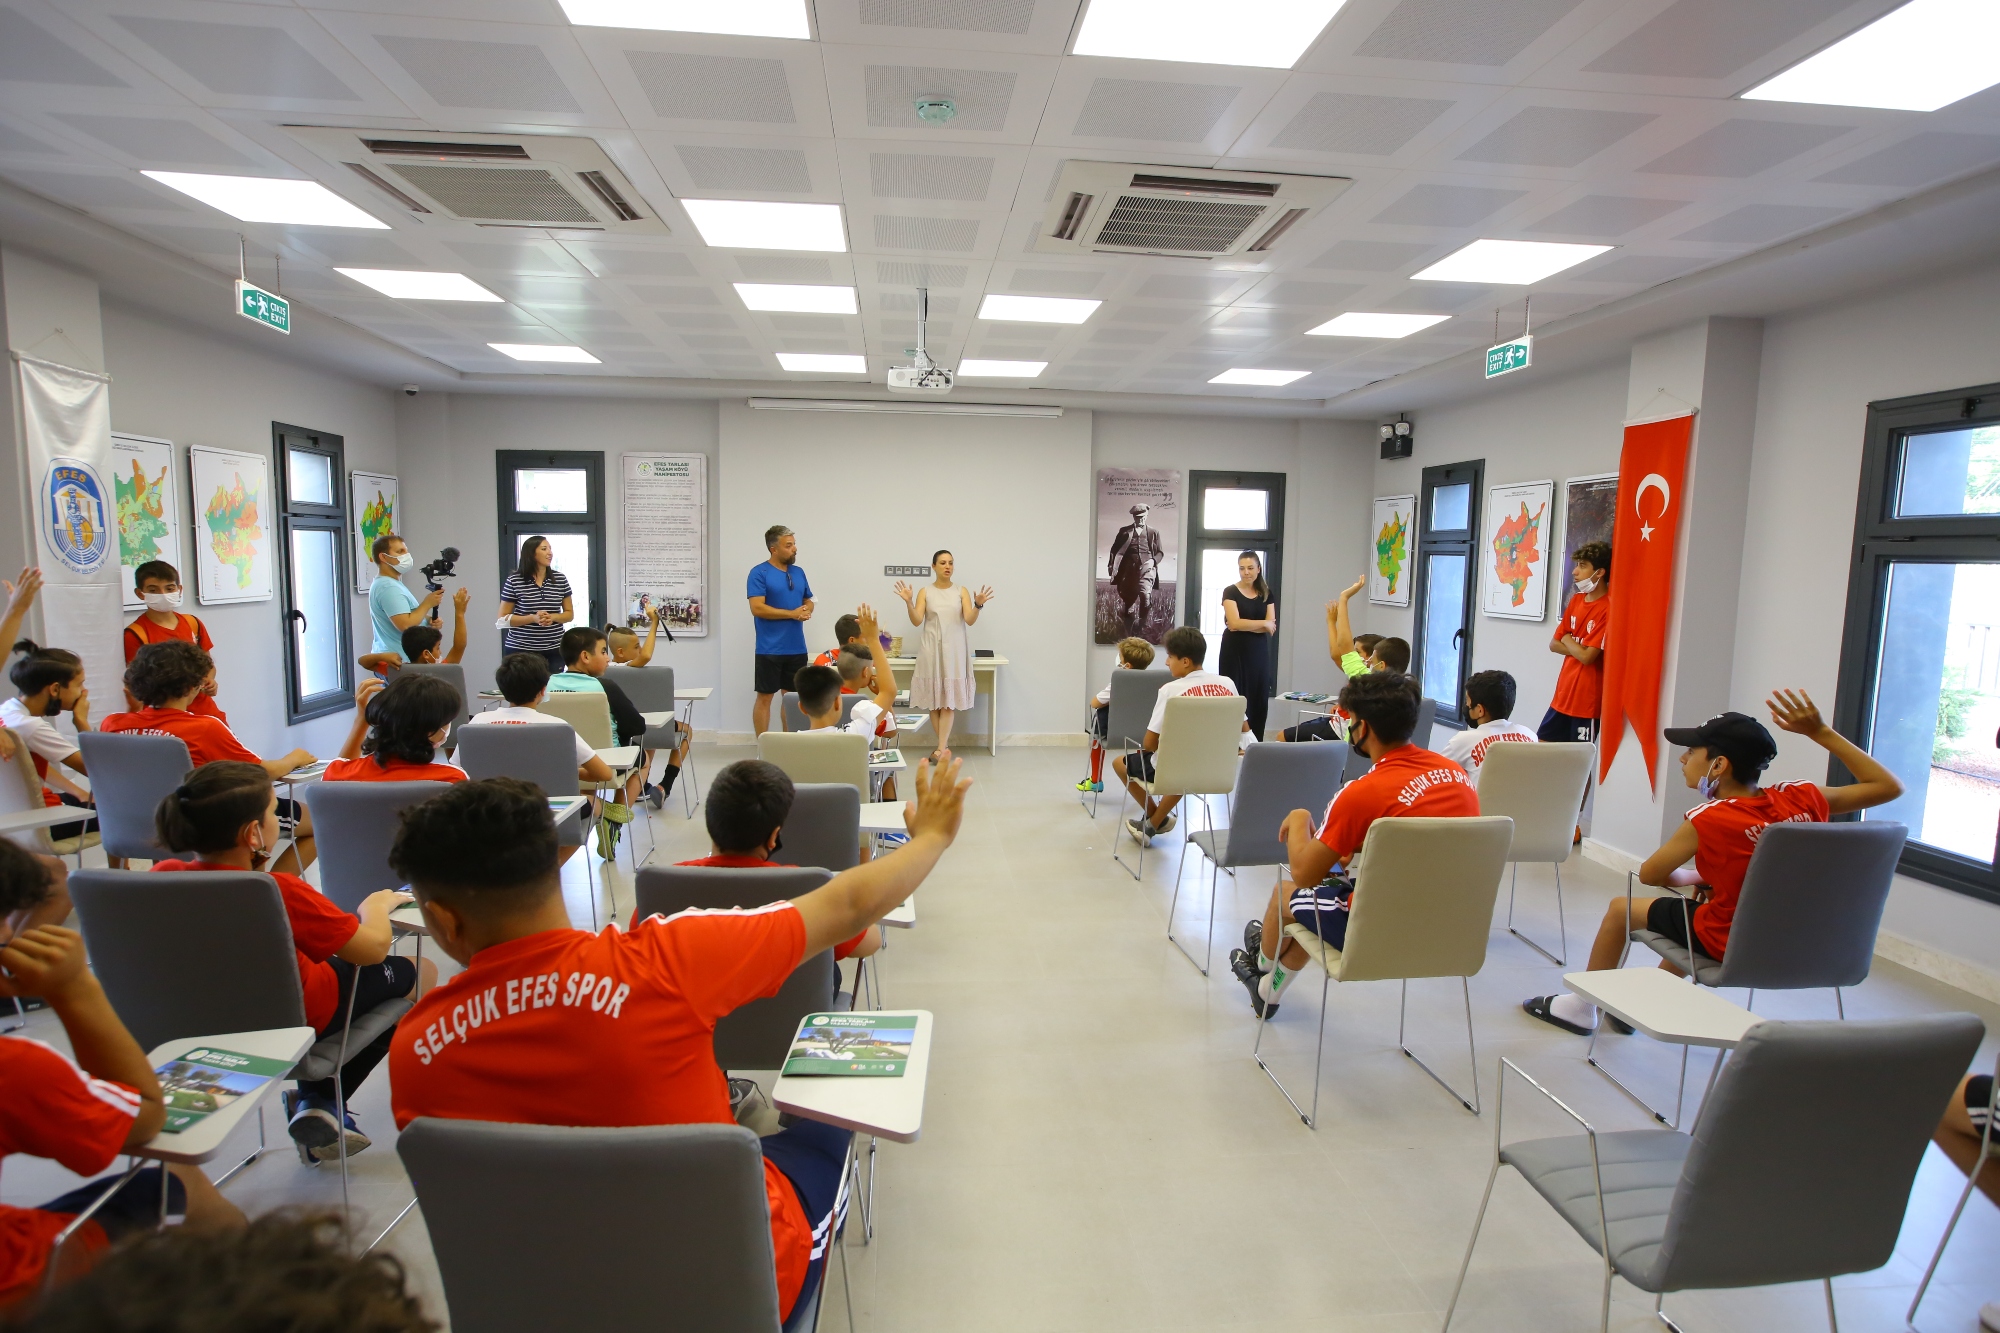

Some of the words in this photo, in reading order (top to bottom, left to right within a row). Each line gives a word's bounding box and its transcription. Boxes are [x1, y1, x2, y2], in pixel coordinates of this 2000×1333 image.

[270, 313, 286, 326] EXIT
[1489, 361, 1503, 372] EXIT
[55, 469, 87, 483] EFES
[1577, 726, 1590, 740] 21
[1397, 774, 1433, 807] SELÇUK
[1427, 769, 1453, 785] EFES
[413, 986, 501, 1065] SELÇUK
[506, 971, 559, 1015] EFES
[562, 971, 631, 1019] SPOR
